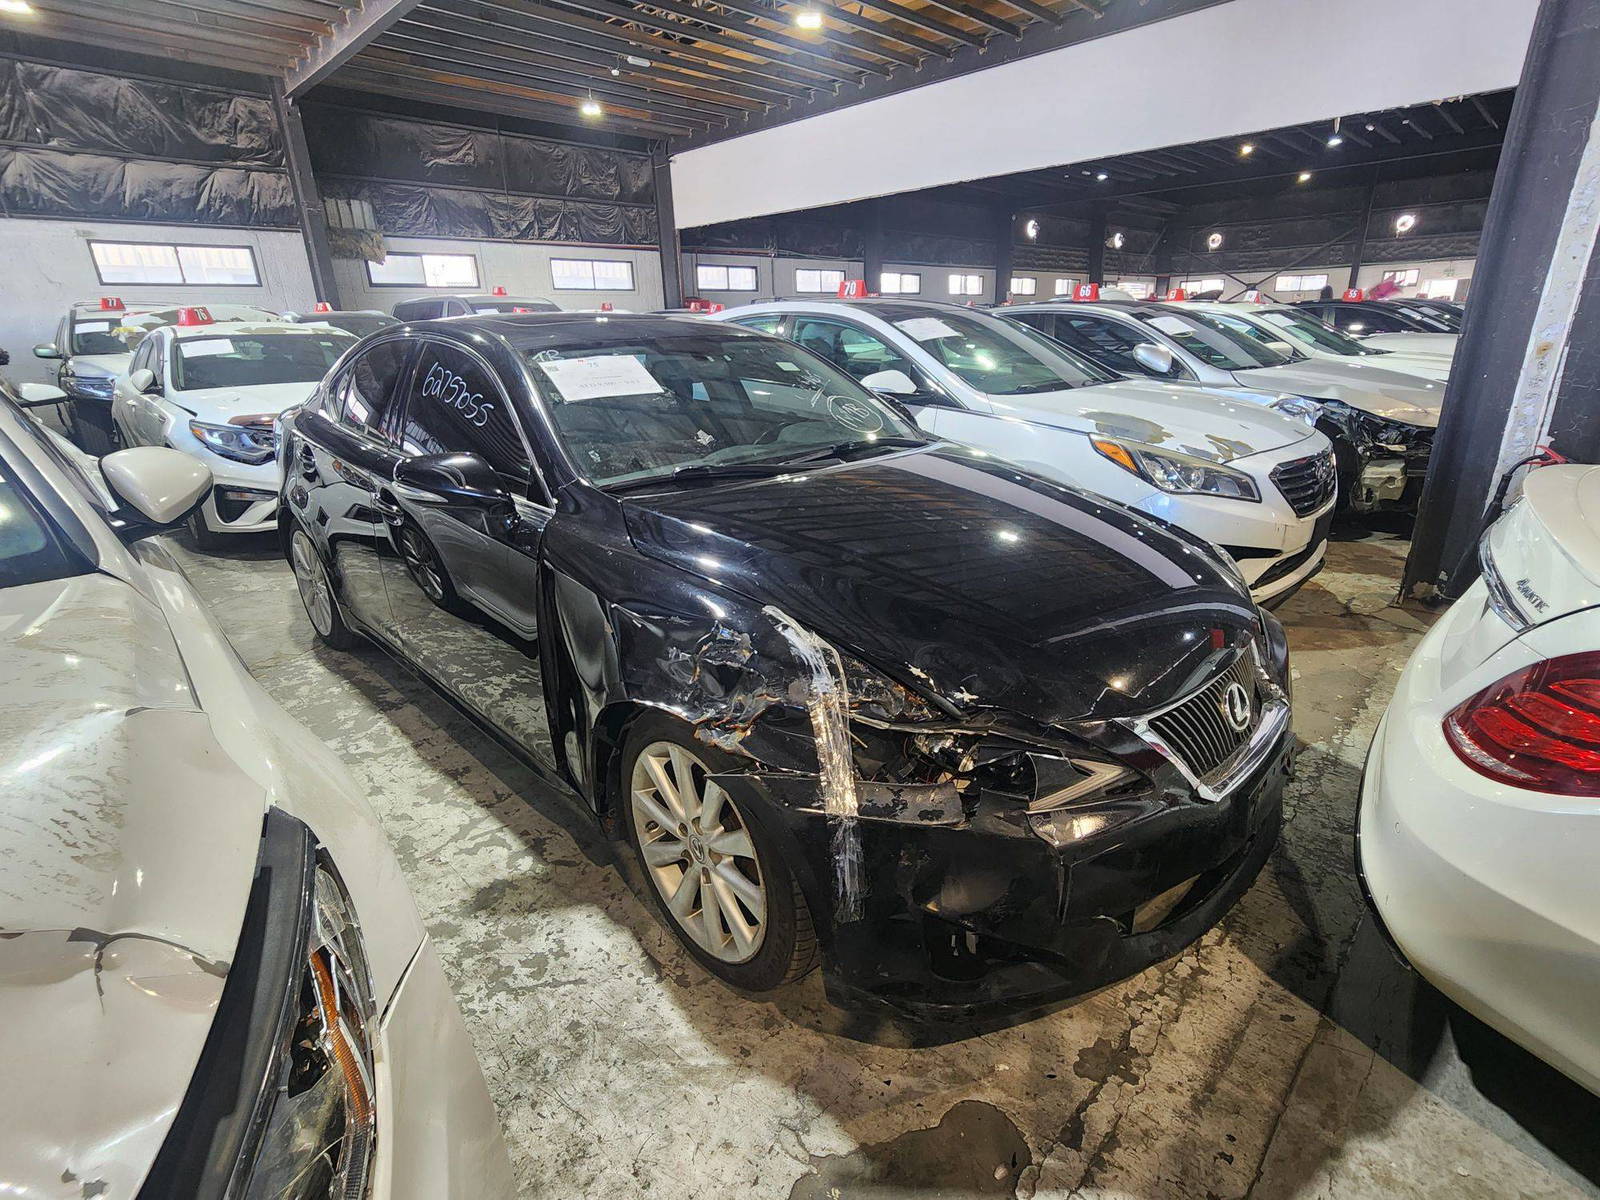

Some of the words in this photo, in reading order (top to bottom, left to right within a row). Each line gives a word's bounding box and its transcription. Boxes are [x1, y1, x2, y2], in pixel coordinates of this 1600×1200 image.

[844, 280, 857, 296] 70
[1079, 285, 1092, 297] 66
[194, 308, 208, 321] 76
